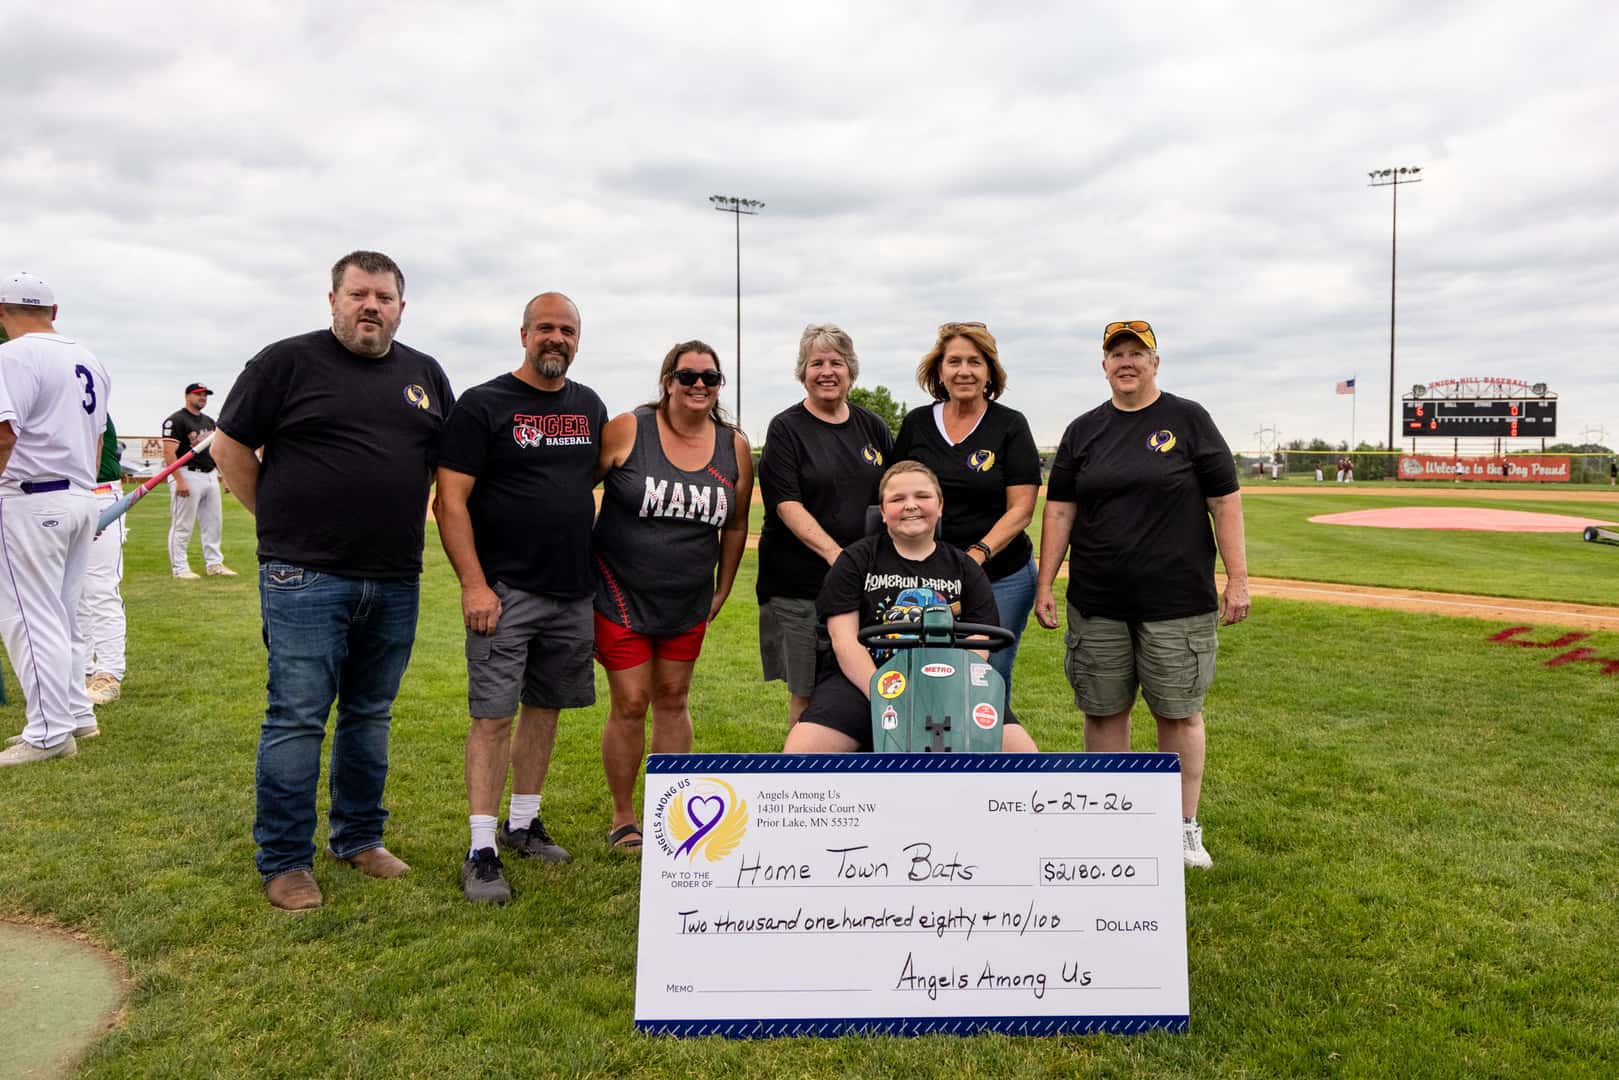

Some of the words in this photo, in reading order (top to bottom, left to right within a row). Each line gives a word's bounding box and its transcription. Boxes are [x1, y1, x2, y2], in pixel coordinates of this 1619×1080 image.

[75, 363, 97, 415] 3
[1429, 379, 1456, 388] UNION
[1484, 377, 1528, 388] BASEBALL
[514, 413, 590, 436] TIGER
[546, 436, 592, 446] BASEBALL
[1474, 463, 1484, 473] to
[1508, 463, 1528, 478] Dog
[1531, 463, 1567, 476] Pound
[639, 476, 728, 527] MAMA
[864, 572, 918, 593] HOMERUN
[923, 666, 953, 674] METRO
[677, 778, 691, 789] US
[655, 786, 677, 818] AMONG
[757, 790, 789, 801] Angels
[792, 790, 825, 801] Among
[828, 790, 840, 799] Us
[1031, 790, 1133, 813] 6-27-26
[758, 804, 784, 813] 14301
[788, 804, 827, 813] Parkside
[829, 804, 855, 813] Court
[858, 804, 876, 813] NW
[757, 818, 779, 827] Prior
[782, 818, 807, 828] Lake,
[810, 818, 828, 827] MN
[831, 817, 859, 827] 55372
[653, 821, 674, 856] ANGELS
[661, 871, 677, 879] PAY
[680, 871, 691, 879] TO
[694, 871, 710, 879] THE
[737, 851, 811, 888] Home
[826, 846, 888, 878] Town
[903, 843, 978, 881] Bats
[1044, 862, 1136, 882] $2180.00
[678, 910, 707, 934] Two
[714, 907, 802, 934] thousand
[917, 907, 976, 941] eighty
[896, 952, 969, 1000] Angels
[977, 960, 1047, 999] Among
[1062, 960, 1092, 986] Us
